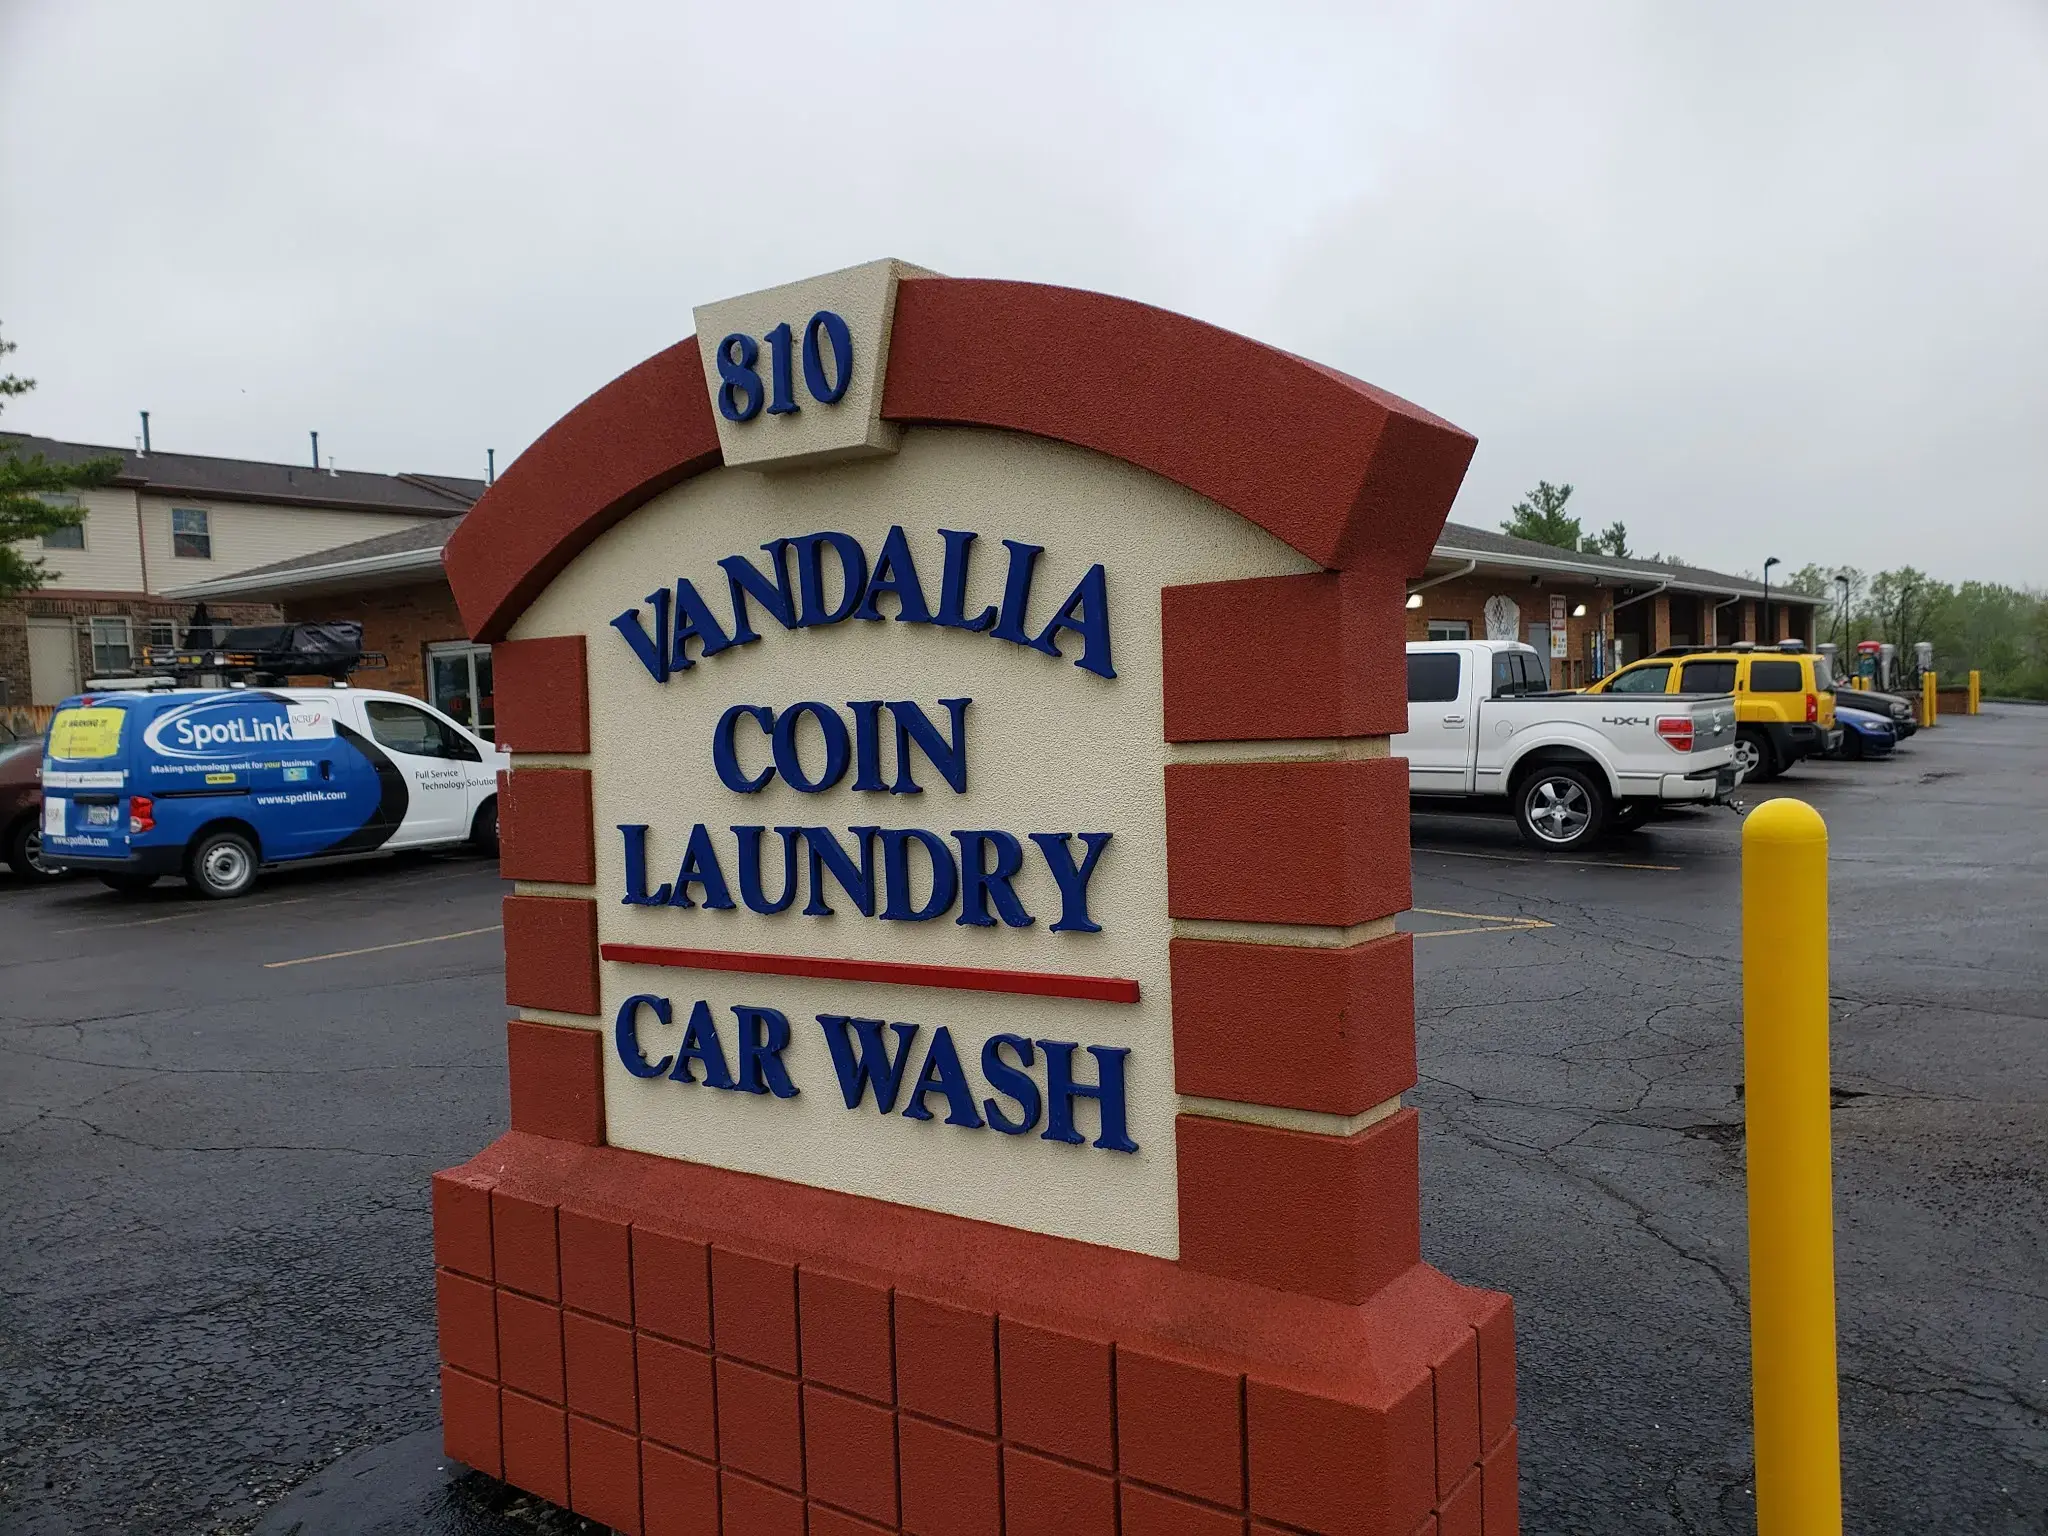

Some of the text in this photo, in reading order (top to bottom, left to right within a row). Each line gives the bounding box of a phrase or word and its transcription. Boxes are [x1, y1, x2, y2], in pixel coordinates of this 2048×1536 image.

[716, 310, 853, 424] 810
[609, 524, 1118, 684] VANDALIA
[176, 715, 293, 750] SpotLink
[712, 696, 972, 795] COIN
[151, 759, 316, 775] Making technology work for your business.
[415, 769, 458, 780] Full Service
[257, 790, 347, 806] www.spotlink.com
[421, 781, 465, 792] Technology
[52, 834, 109, 848] www.spotlink.com
[618, 822, 1114, 935] LAUNDRY
[613, 993, 1140, 1154] CAR WASH
